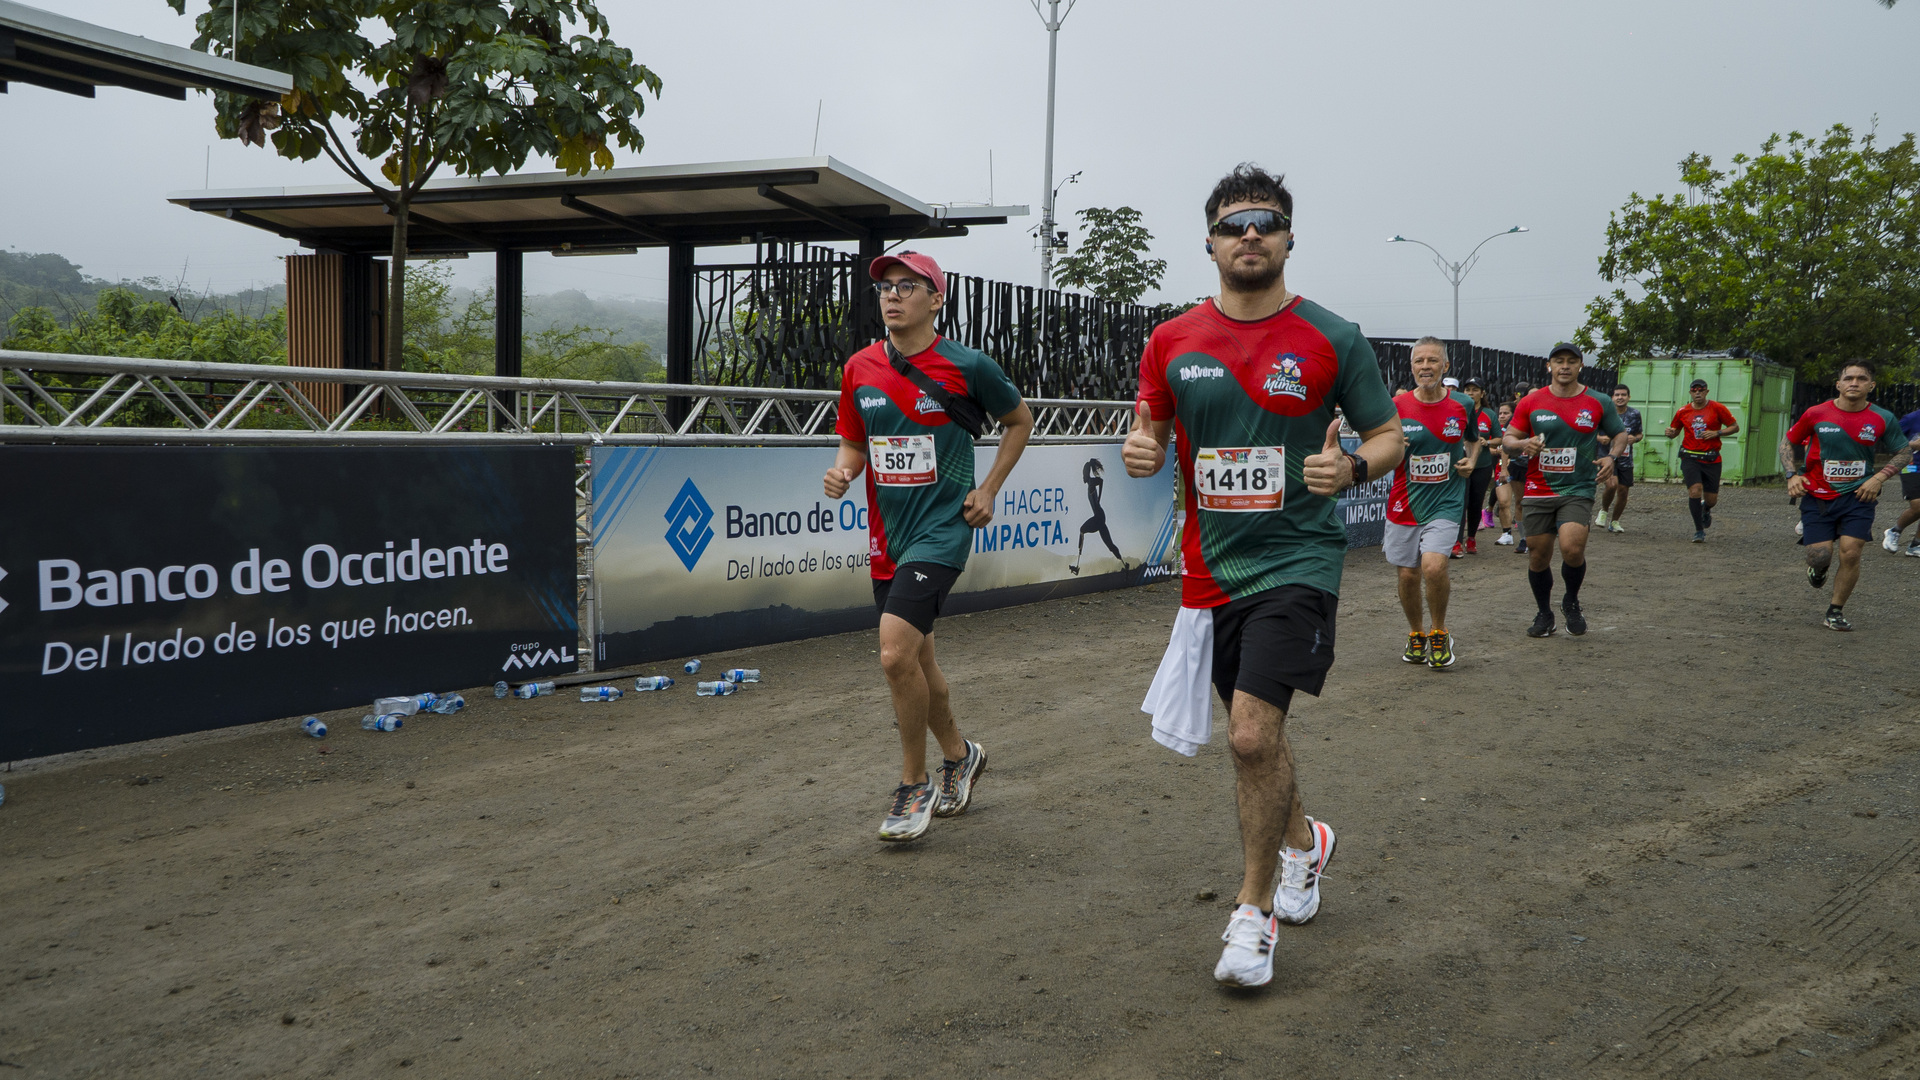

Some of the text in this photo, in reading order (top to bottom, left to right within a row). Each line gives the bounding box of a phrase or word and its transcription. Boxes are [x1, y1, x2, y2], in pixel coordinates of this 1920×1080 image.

[1263, 377, 1307, 395] Muñeca
[885, 452, 916, 470] 587
[1415, 463, 1444, 475] 1200
[1544, 455, 1570, 465] 2149
[1830, 467, 1858, 476] 2082
[1206, 467, 1267, 491] 1418
[1004, 487, 1069, 516] HACER,
[726, 505, 801, 539] Banco
[807, 502, 834, 533] de
[975, 519, 1069, 554] IMPACTA.
[38, 538, 509, 611] Banco de Occidente
[727, 550, 871, 581] Del lado de los que
[1143, 564, 1171, 578] AVAL
[41, 605, 474, 676] Del lado de los que hacen.
[510, 641, 540, 652] Grupo
[501, 645, 575, 672] AVAL
